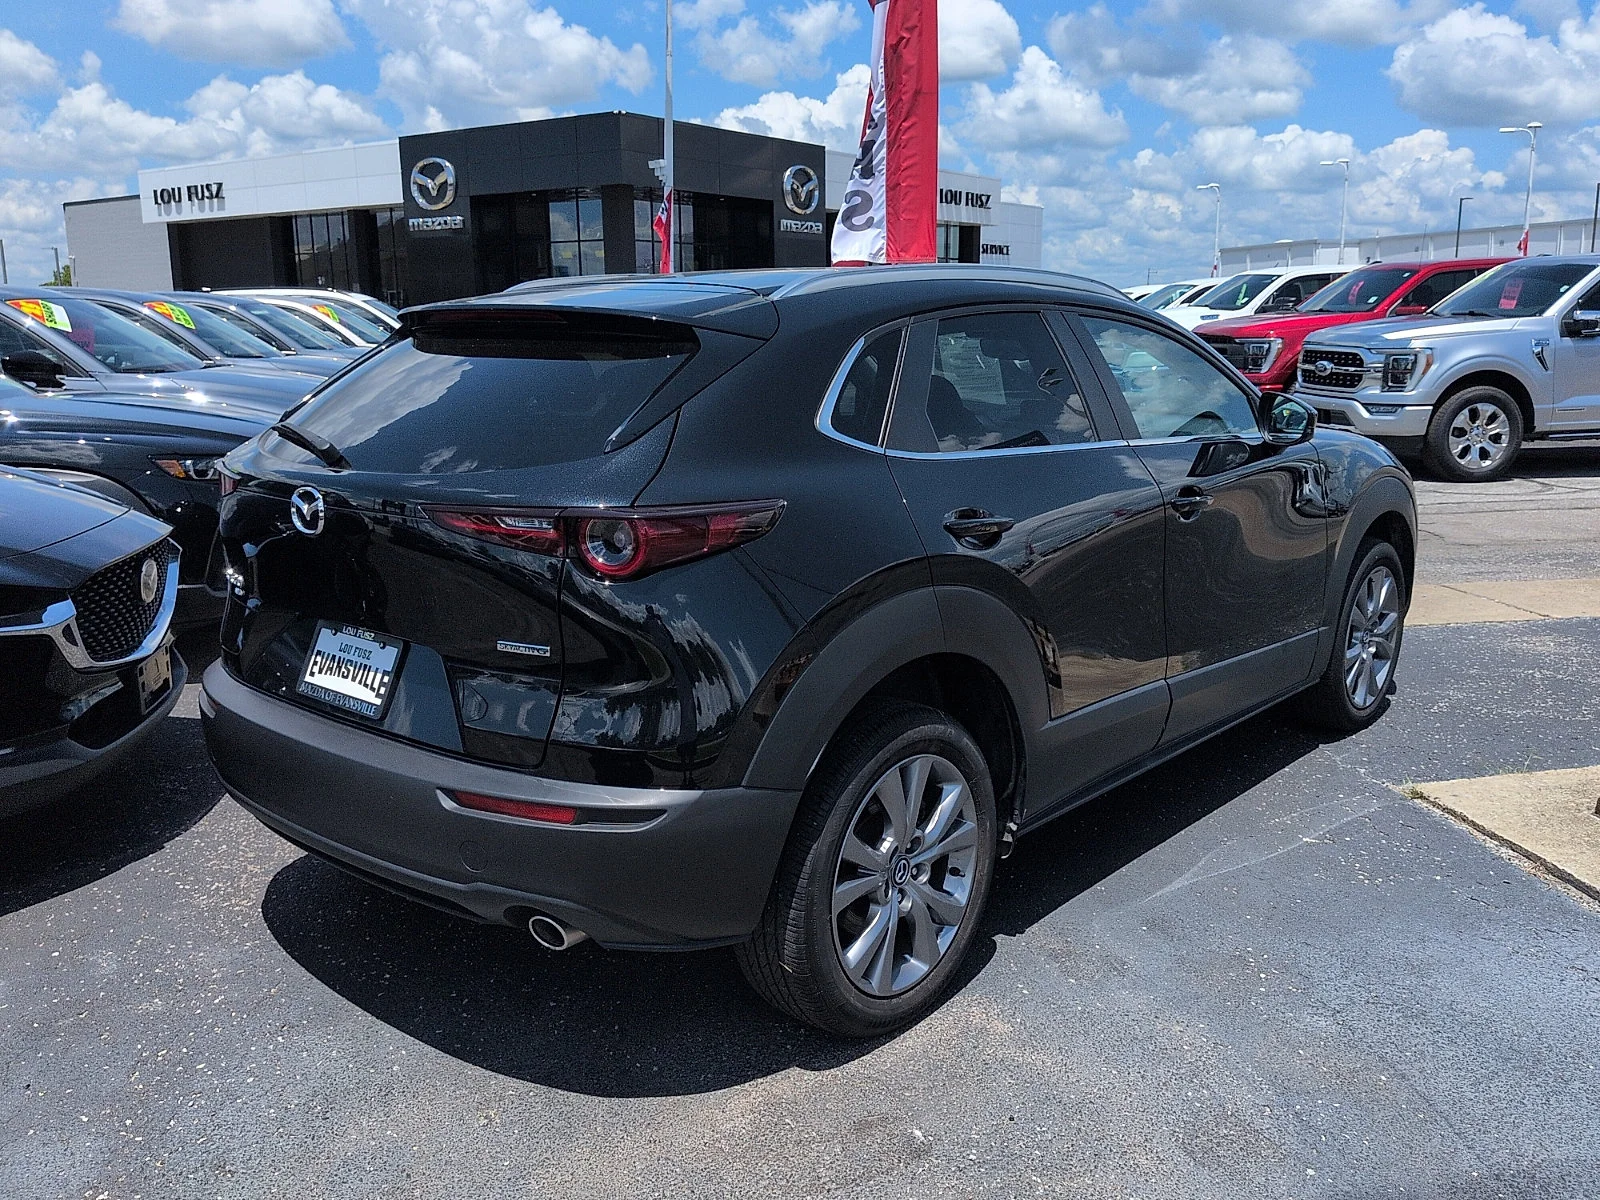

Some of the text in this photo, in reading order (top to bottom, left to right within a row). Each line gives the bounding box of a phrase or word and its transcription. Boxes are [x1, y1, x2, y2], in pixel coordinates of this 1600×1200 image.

[153, 182, 225, 205] LOU FUSZ
[939, 188, 992, 209] LOU FUSZ
[409, 215, 464, 231] mazda
[780, 219, 823, 235] mazda
[981, 243, 1010, 255] SERVICE
[342, 625, 375, 640] LOU FUSZ
[338, 642, 373, 660] LOU FUSZ
[308, 649, 391, 699] EVANSVILLE
[299, 682, 377, 716] MAZDA OF EVANSVILLE
